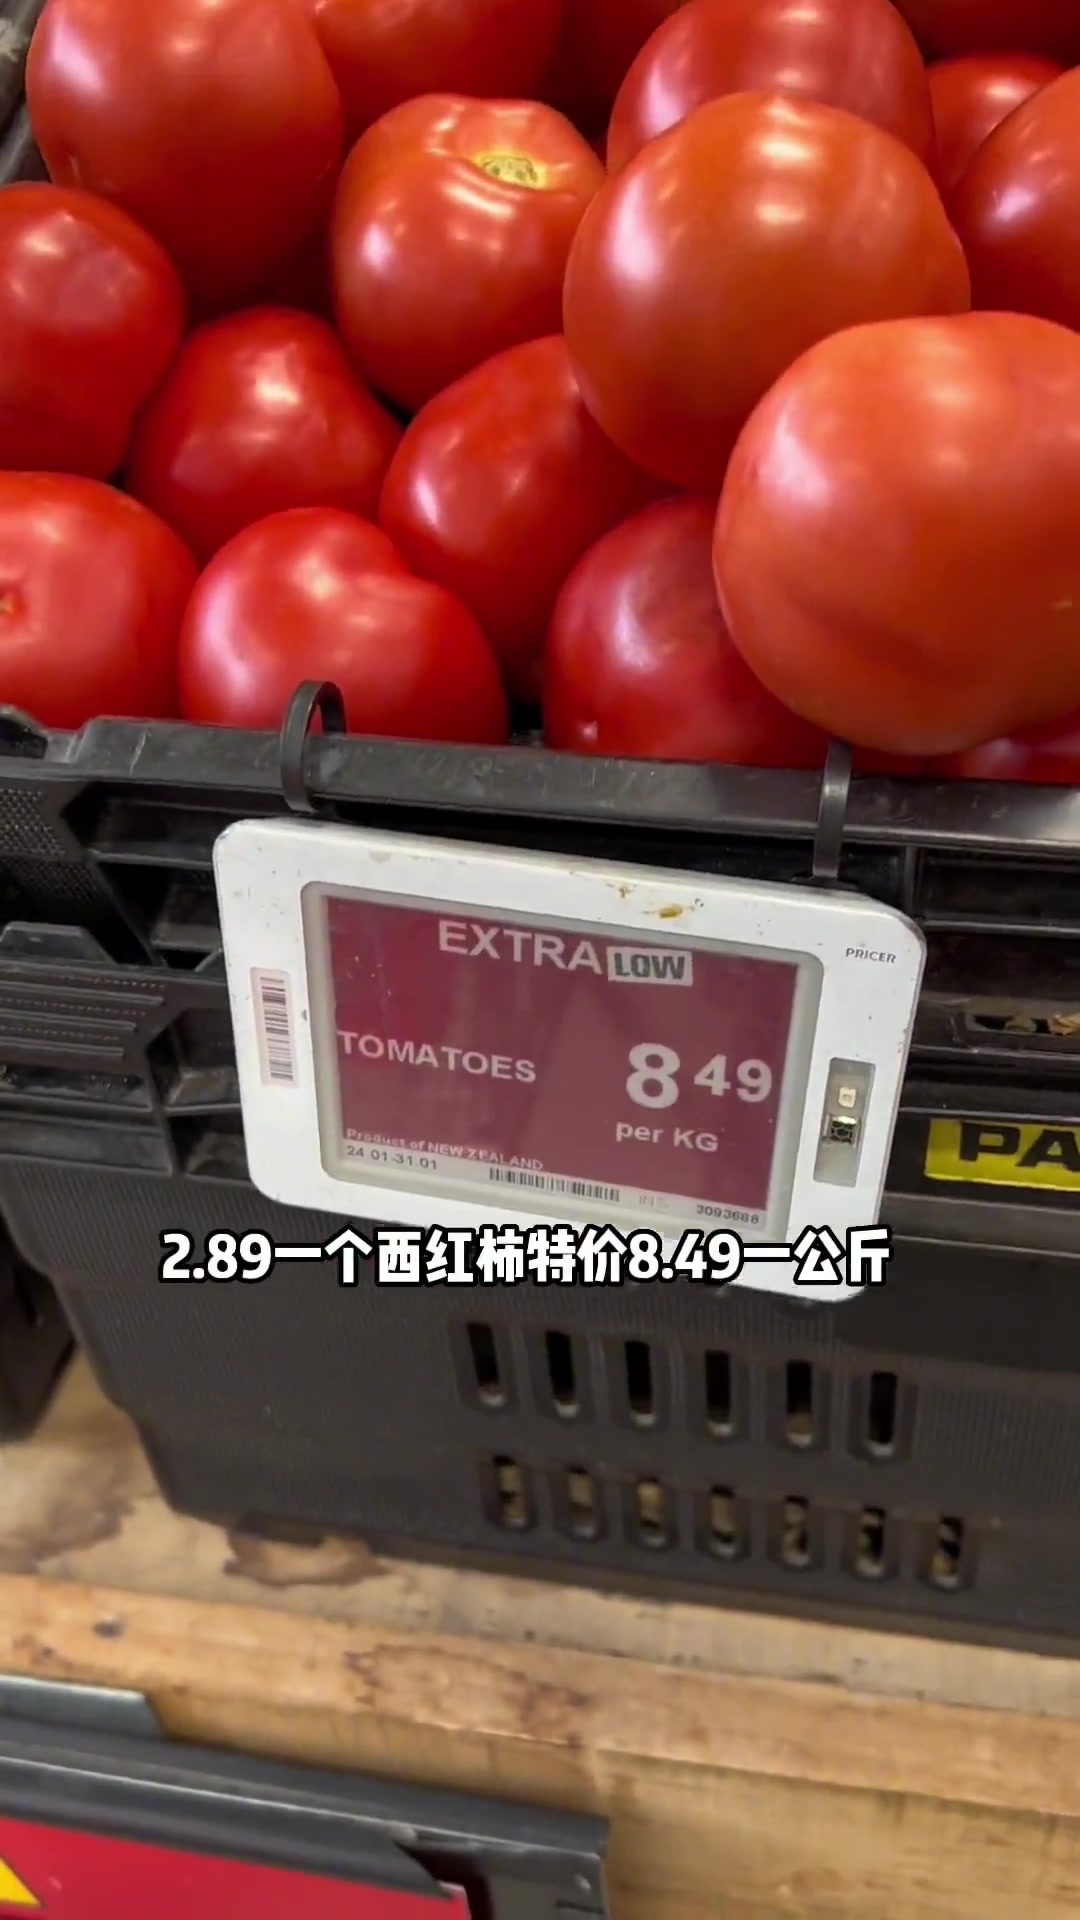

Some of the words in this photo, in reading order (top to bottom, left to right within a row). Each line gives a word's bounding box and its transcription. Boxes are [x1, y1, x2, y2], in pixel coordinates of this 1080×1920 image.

[438, 919, 602, 975] EXTRA
[614, 952, 685, 980] LOW
[845, 947, 896, 964] PRICER
[337, 1030, 536, 1083] TOMATOES
[626, 1042, 680, 1109] 8
[694, 1054, 772, 1102] 49
[346, 1128, 405, 1146] Product
[409, 1140, 426, 1151] of
[428, 1142, 463, 1157] NEW
[468, 1147, 543, 1171] ZEALAND
[616, 1122, 663, 1143] per
[674, 1128, 718, 1152] KG
[696, 1204, 760, 1225] 3093688
